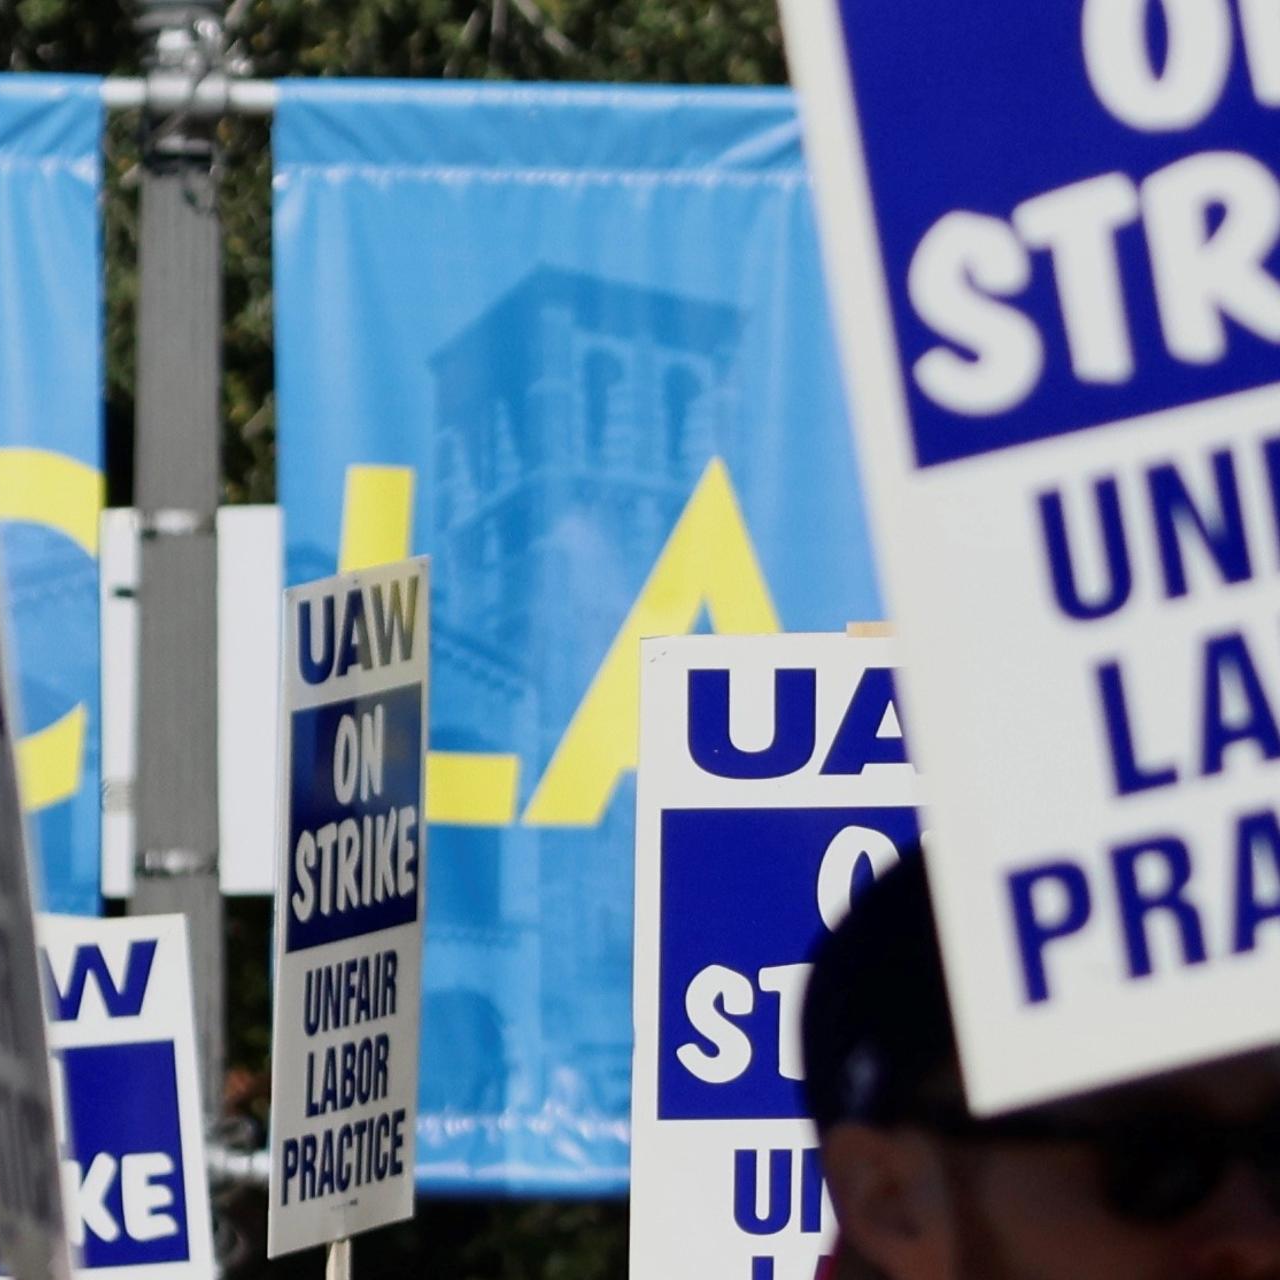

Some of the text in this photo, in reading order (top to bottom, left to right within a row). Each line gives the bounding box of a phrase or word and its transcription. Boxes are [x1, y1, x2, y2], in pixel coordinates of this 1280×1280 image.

[1037, 434, 1280, 624] UN
[297, 573, 420, 688] UAW
[333, 703, 384, 807] ON
[291, 804, 416, 924] STRIKE
[302, 949, 398, 1038] UNFAIR
[305, 1031, 389, 1120] LABOR
[280, 1109, 407, 1208] PRACTICE
